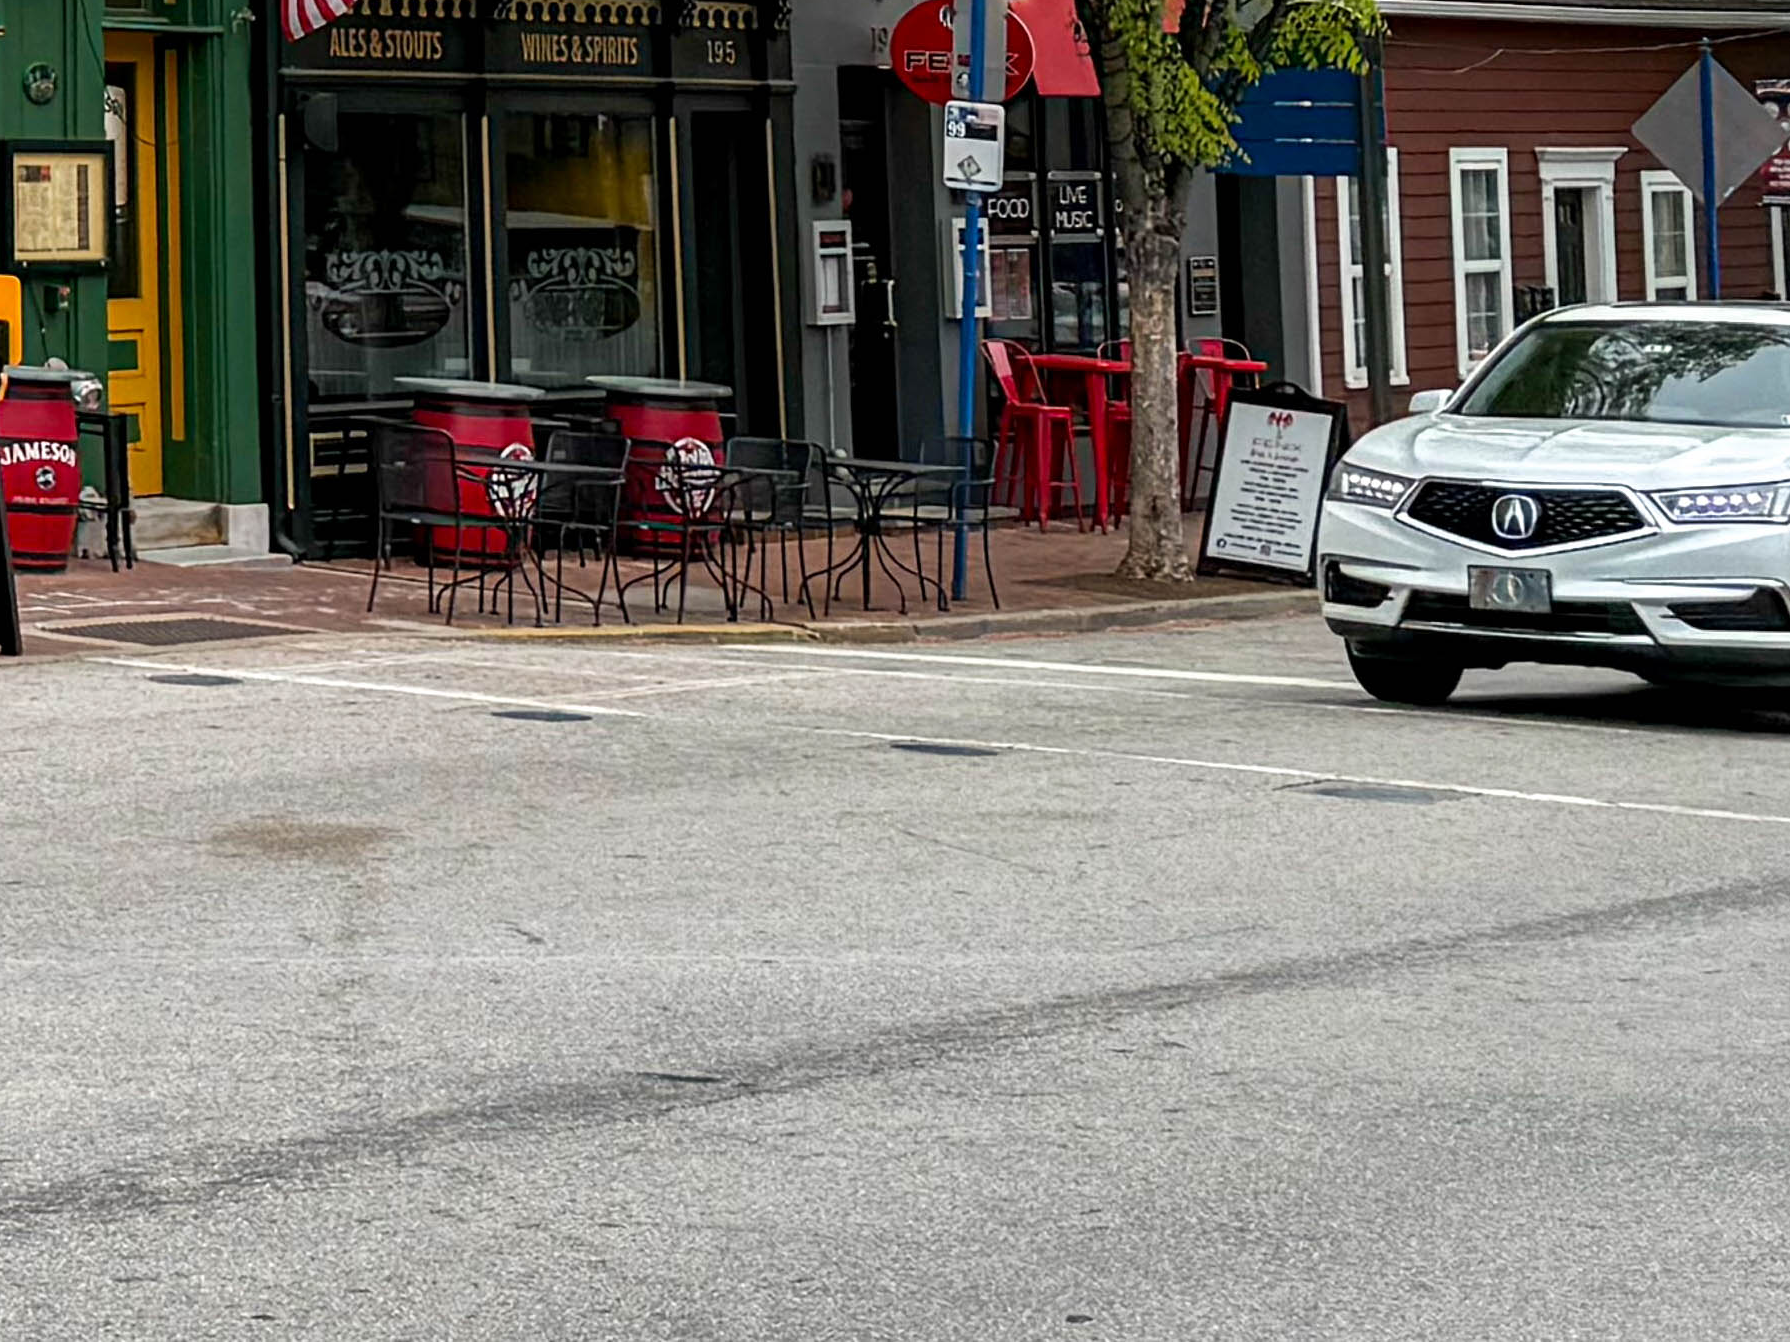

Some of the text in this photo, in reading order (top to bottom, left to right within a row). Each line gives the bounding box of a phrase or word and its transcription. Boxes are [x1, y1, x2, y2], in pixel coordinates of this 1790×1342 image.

[329, 28, 442, 60] ALES & STOUTS
[521, 32, 638, 65] WINES & SPIRITS
[706, 39, 737, 66] 195
[947, 120, 967, 138] 99
[1059, 185, 1088, 204] LIVE
[987, 198, 1030, 218] FOOD
[1055, 210, 1094, 228] MUSIC
